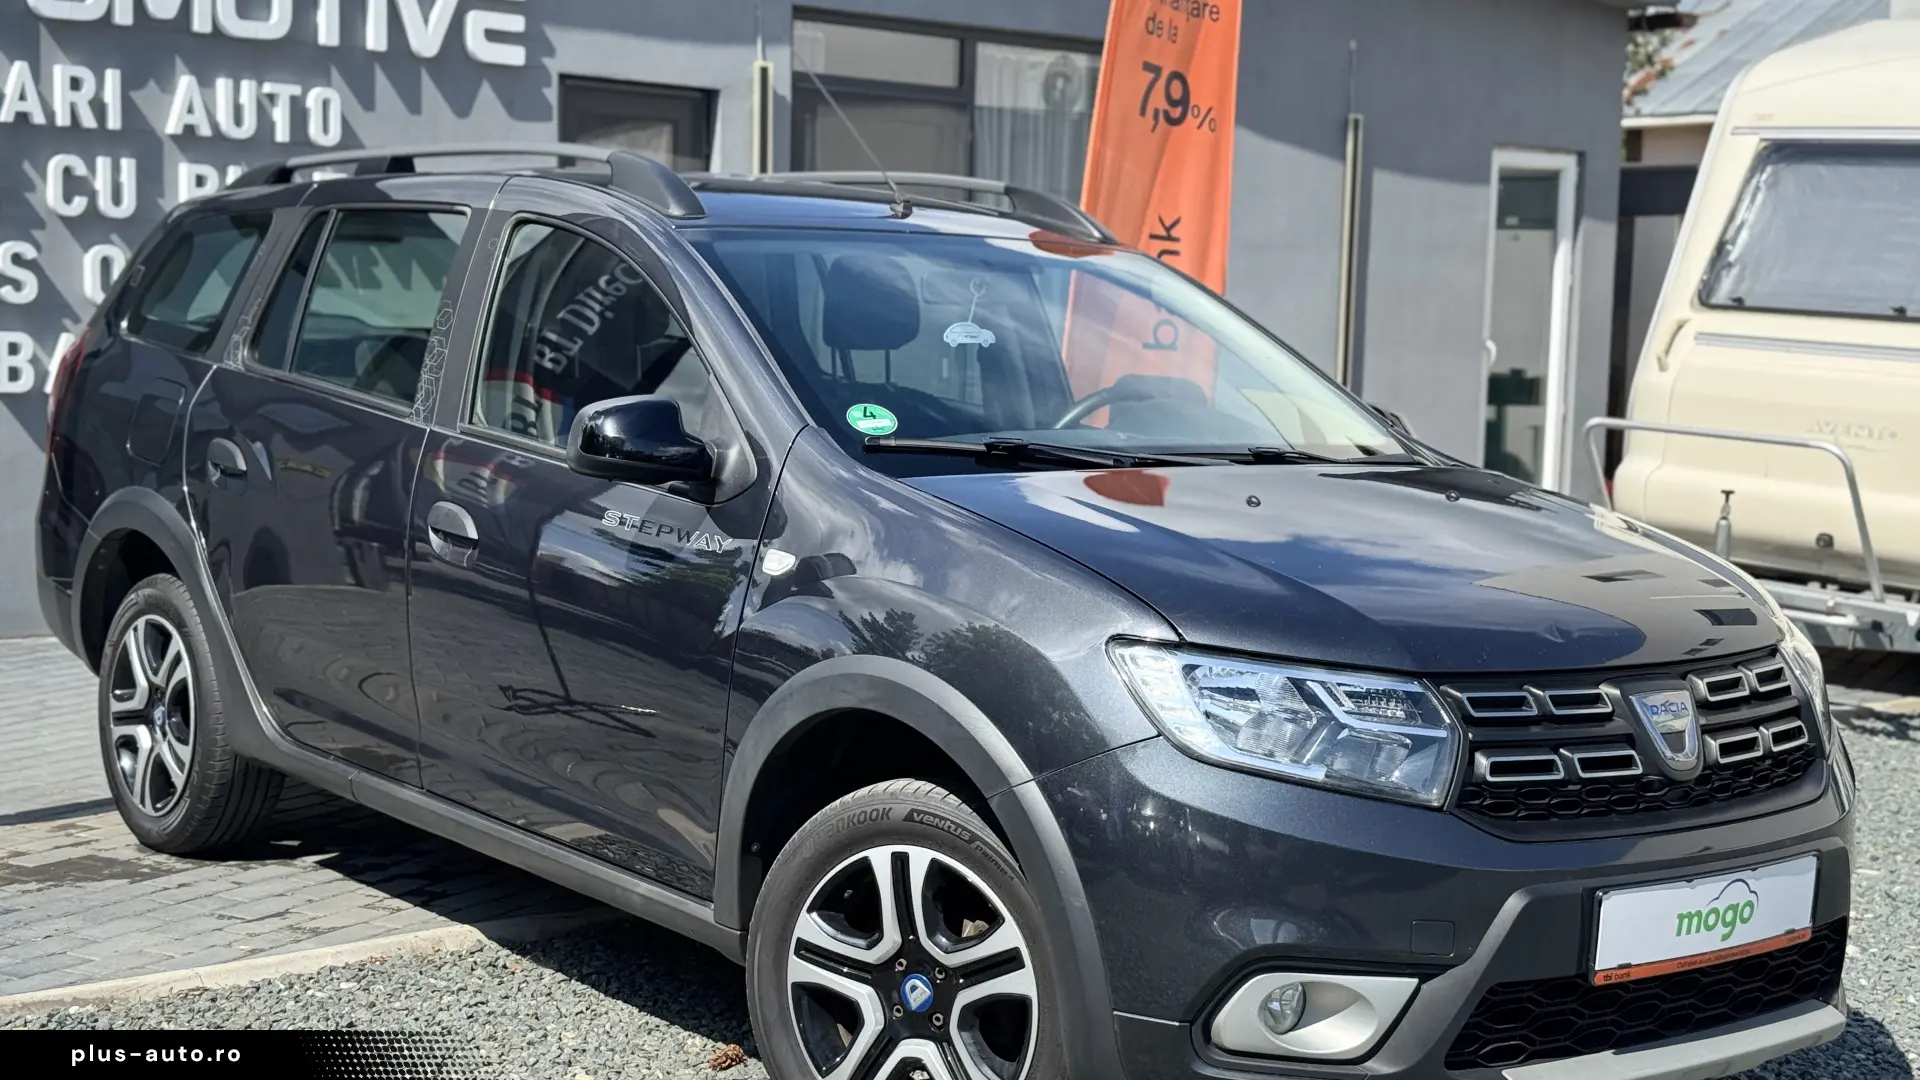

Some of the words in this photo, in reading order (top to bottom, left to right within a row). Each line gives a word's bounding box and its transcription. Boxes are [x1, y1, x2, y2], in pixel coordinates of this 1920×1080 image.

[27, 0, 526, 67] TIVE
[1145, 12, 1163, 38] de
[1168, 17, 1178, 43] la
[165, 75, 342, 147] AUTO
[46, 154, 137, 219] CU
[1142, 215, 1181, 351] bnk
[863, 406, 876, 419] 4
[602, 510, 733, 553] STEPWAY
[1650, 700, 1688, 715] DACIA
[1676, 900, 1754, 942] mogo
[1614, 971, 1631, 980] bank
